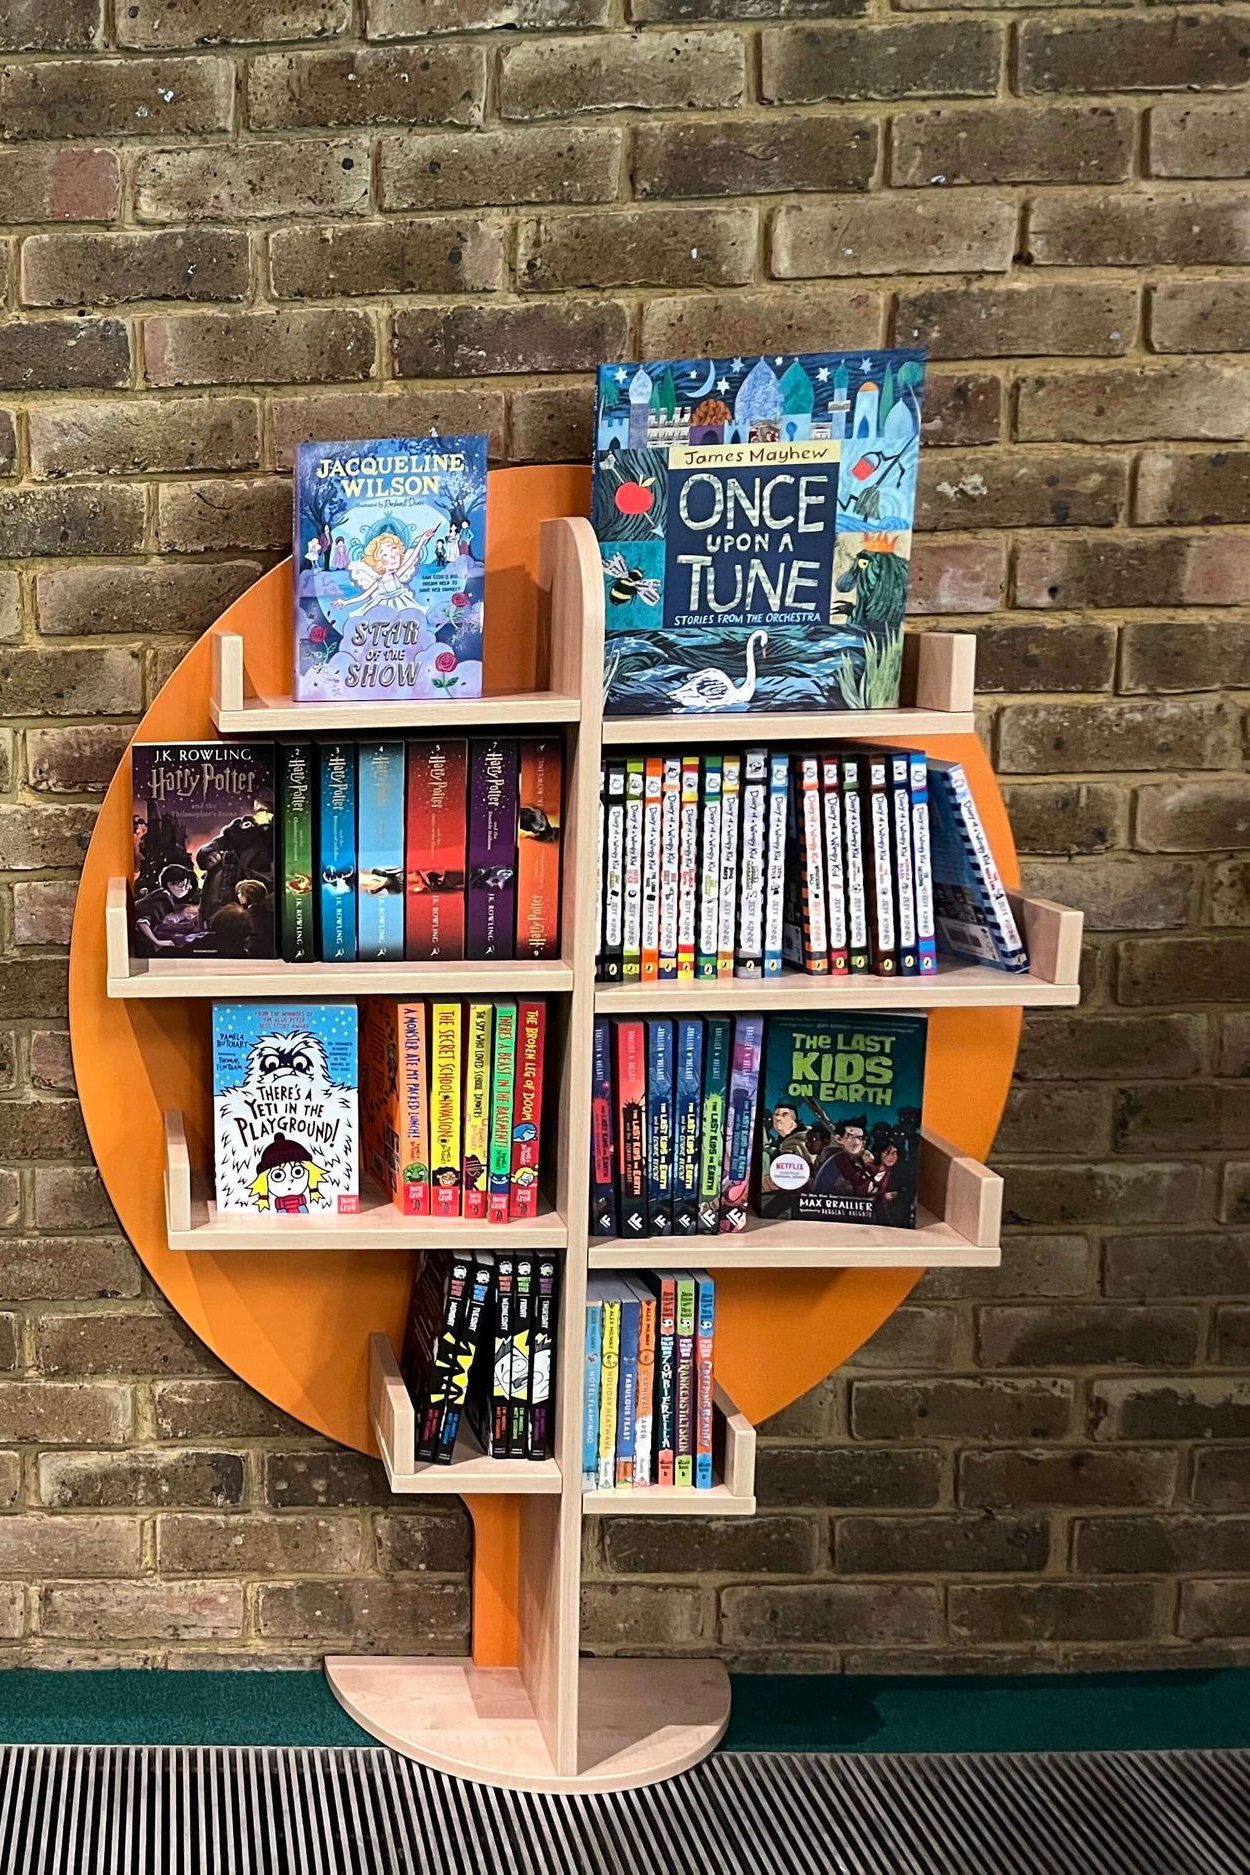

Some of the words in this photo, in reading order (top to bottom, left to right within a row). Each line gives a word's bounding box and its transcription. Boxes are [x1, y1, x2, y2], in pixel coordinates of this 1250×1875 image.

[317, 453, 464, 479] JACQUELINE
[684, 450, 743, 465] James
[750, 446, 829, 464] Mayhew
[341, 476, 440, 498] WILSON
[679, 473, 828, 533] ONCE
[706, 534, 772, 554] UPON
[778, 532, 794, 552] A
[676, 555, 820, 612] TUNE
[674, 614, 714, 626] STORIES
[718, 614, 743, 625] FROM
[746, 613, 764, 624] THE
[766, 612, 820, 624] ORCHESTRA
[351, 620, 420, 648] STAR
[366, 650, 380, 662] OF
[384, 648, 405, 661] THE
[345, 662, 422, 688] SHOW
[154, 750, 176, 764] J.K.
[180, 749, 252, 761] ROWLING
[485, 752, 503, 780] Harry
[148, 766, 200, 800] Harry
[200, 763, 256, 800] Potter
[485, 779, 505, 807] Potter
[827, 797, 838, 821] Diary
[832, 864, 841, 877] Kid
[438, 1010, 454, 1026] THE
[526, 1010, 539, 1024] THE
[217, 1040, 248, 1049] BUTCHART
[404, 1017, 420, 1050] MONSTER
[438, 1030, 455, 1060] SECRET
[525, 1027, 538, 1060] BROKEN
[837, 1033, 896, 1053] LAST
[405, 1054, 420, 1066] ATE
[523, 1063, 536, 1077] LEG
[792, 1051, 894, 1085] KIDS
[406, 1069, 418, 1080] MY
[437, 1064, 455, 1096] SCHOOL
[256, 1084, 302, 1100] THERE'S
[305, 1089, 312, 1100] A
[406, 1083, 420, 1110] PACKED
[788, 1083, 813, 1097] ON
[820, 1082, 893, 1106] EARTH
[244, 1099, 279, 1120] YETI
[285, 1103, 298, 1114] IN
[304, 1104, 324, 1118] THE
[437, 1099, 454, 1138] INVASION
[521, 1092, 535, 1121] DOOM
[234, 1116, 340, 1148] PLAYGROUND!
[407, 1112, 420, 1138] LUNCH!
[709, 1136, 718, 1154] KIDS
[707, 1165, 716, 1190] EARTH
[776, 1162, 804, 1170] NETFLIX
[800, 1198, 822, 1208] MAX
[826, 1200, 873, 1212] BRALLIER
[624, 1374, 632, 1415] FABULOUS
[661, 1354, 673, 1448] ZOMBIERELLA
[678, 1359, 692, 1452] FRANKENSTILTSKIN
[587, 1400, 595, 1444] FLAMINGO
